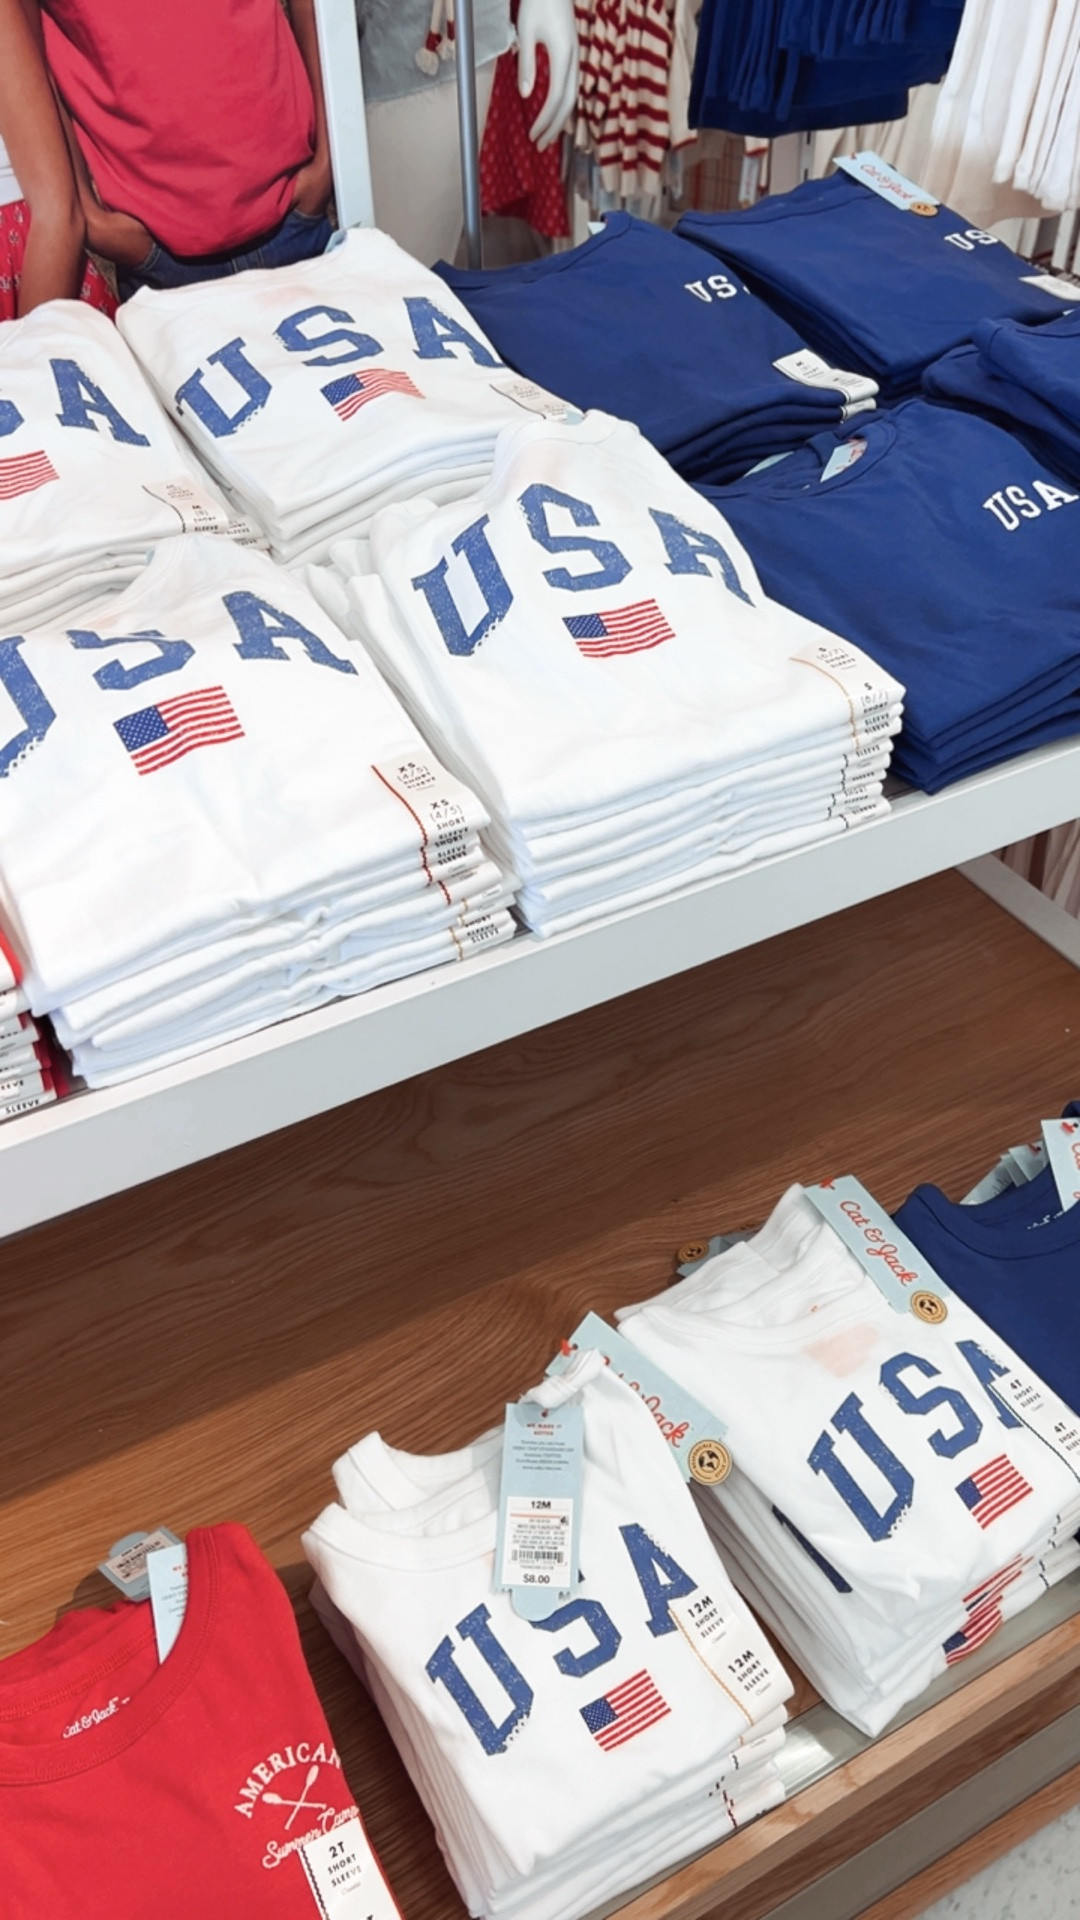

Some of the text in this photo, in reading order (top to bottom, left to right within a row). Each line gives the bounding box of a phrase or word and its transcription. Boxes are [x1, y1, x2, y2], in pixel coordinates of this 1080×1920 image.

[685, 274, 750, 302] US
[175, 296, 503, 438] USA
[982, 480, 1079, 531] USA
[411, 483, 756, 657] USA
[429, 804, 463, 823] (4/5)
[430, 799, 449, 810] XS
[436, 816, 465, 830] SHORT
[5, 1098, 40, 1114] SLEEVE
[840, 1200, 919, 1287] Cat & Jack
[531, 1500, 552, 1510] 12M
[523, 1573, 551, 1584] $8.00
[687, 1595, 714, 1618] 12M
[695, 1608, 719, 1628] SHORT
[700, 1617, 725, 1639] SLEEVE
[727, 1650, 755, 1674] 12M
[737, 1659, 761, 1682] SHORT
[743, 1668, 770, 1692] SLEEVE
[234, 1742, 341, 1819] AMERICAN
[328, 1841, 345, 1859] 2T
[327, 1853, 357, 1875] SHORT
[331, 1864, 363, 1888] SLEEVE
